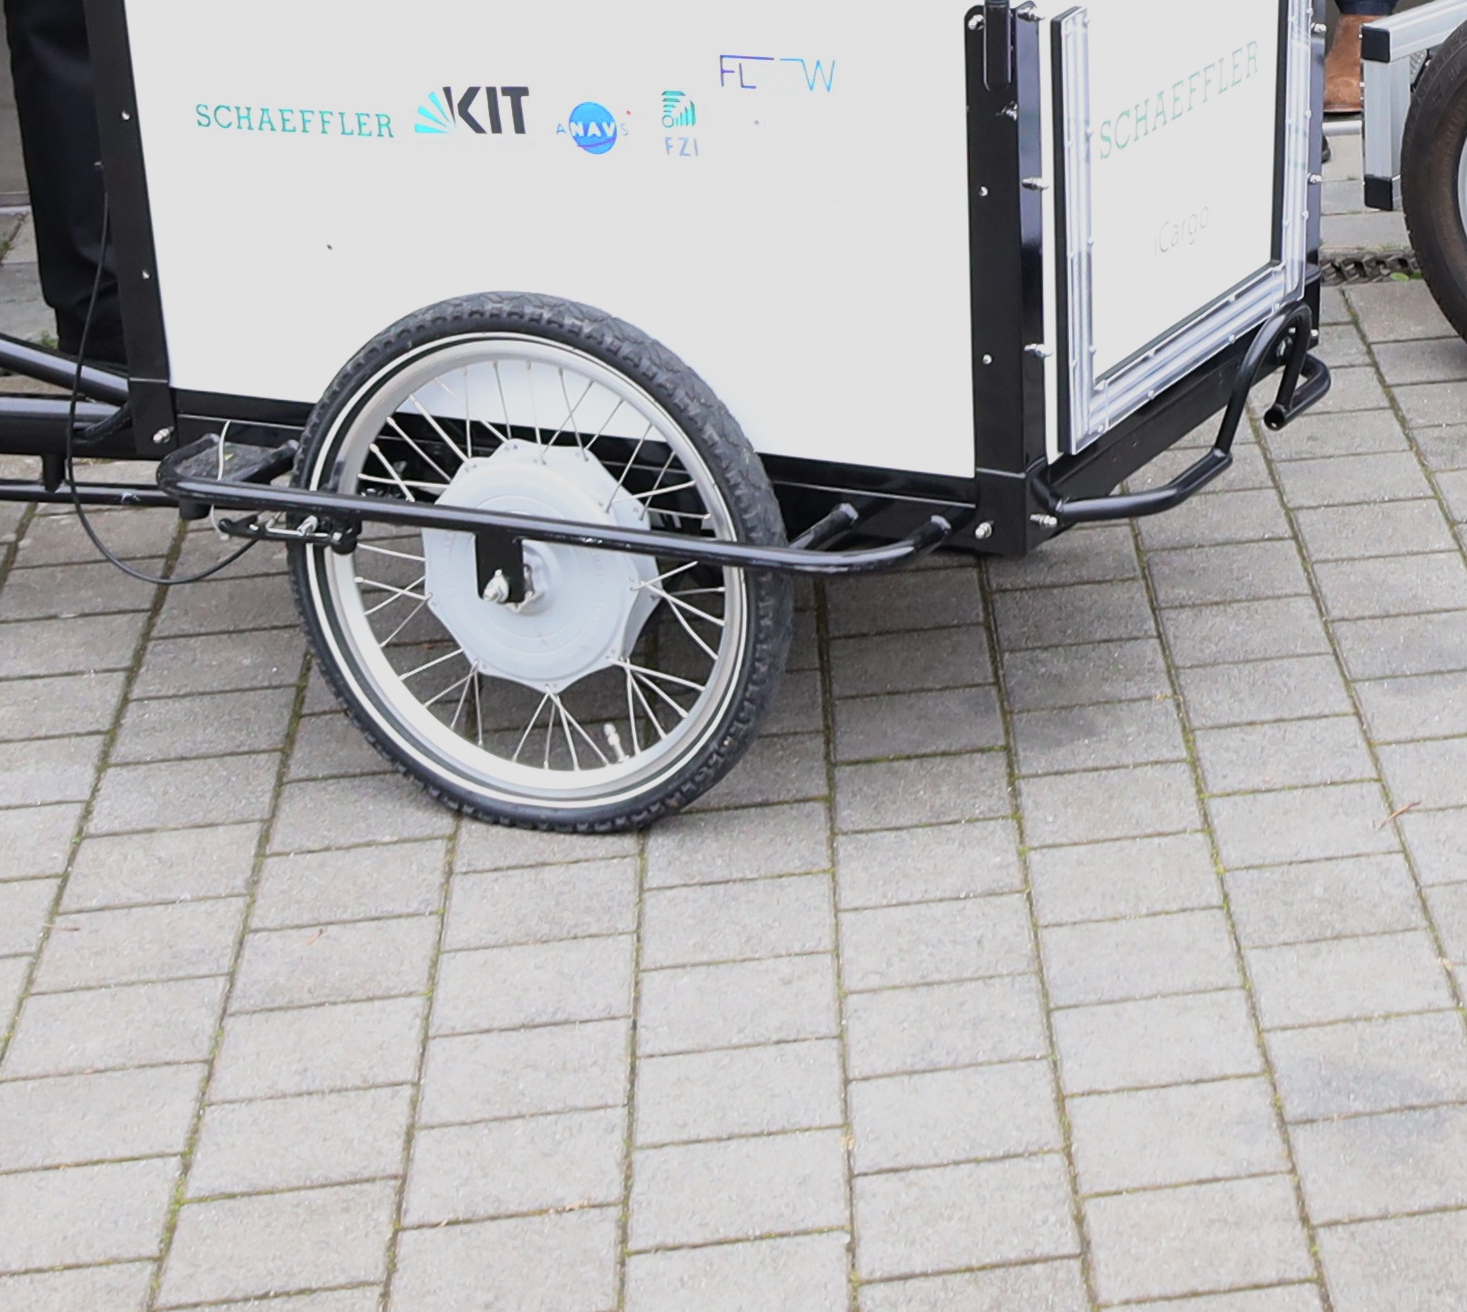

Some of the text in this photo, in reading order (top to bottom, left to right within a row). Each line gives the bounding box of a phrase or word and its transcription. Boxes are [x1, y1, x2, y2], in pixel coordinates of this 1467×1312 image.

[196, 103, 394, 138] SCHAEFFLER
[443, 86, 529, 134] KIT
[1099, 39, 1258, 161] SCHAEFFLER
[665, 137, 699, 157] FZI
